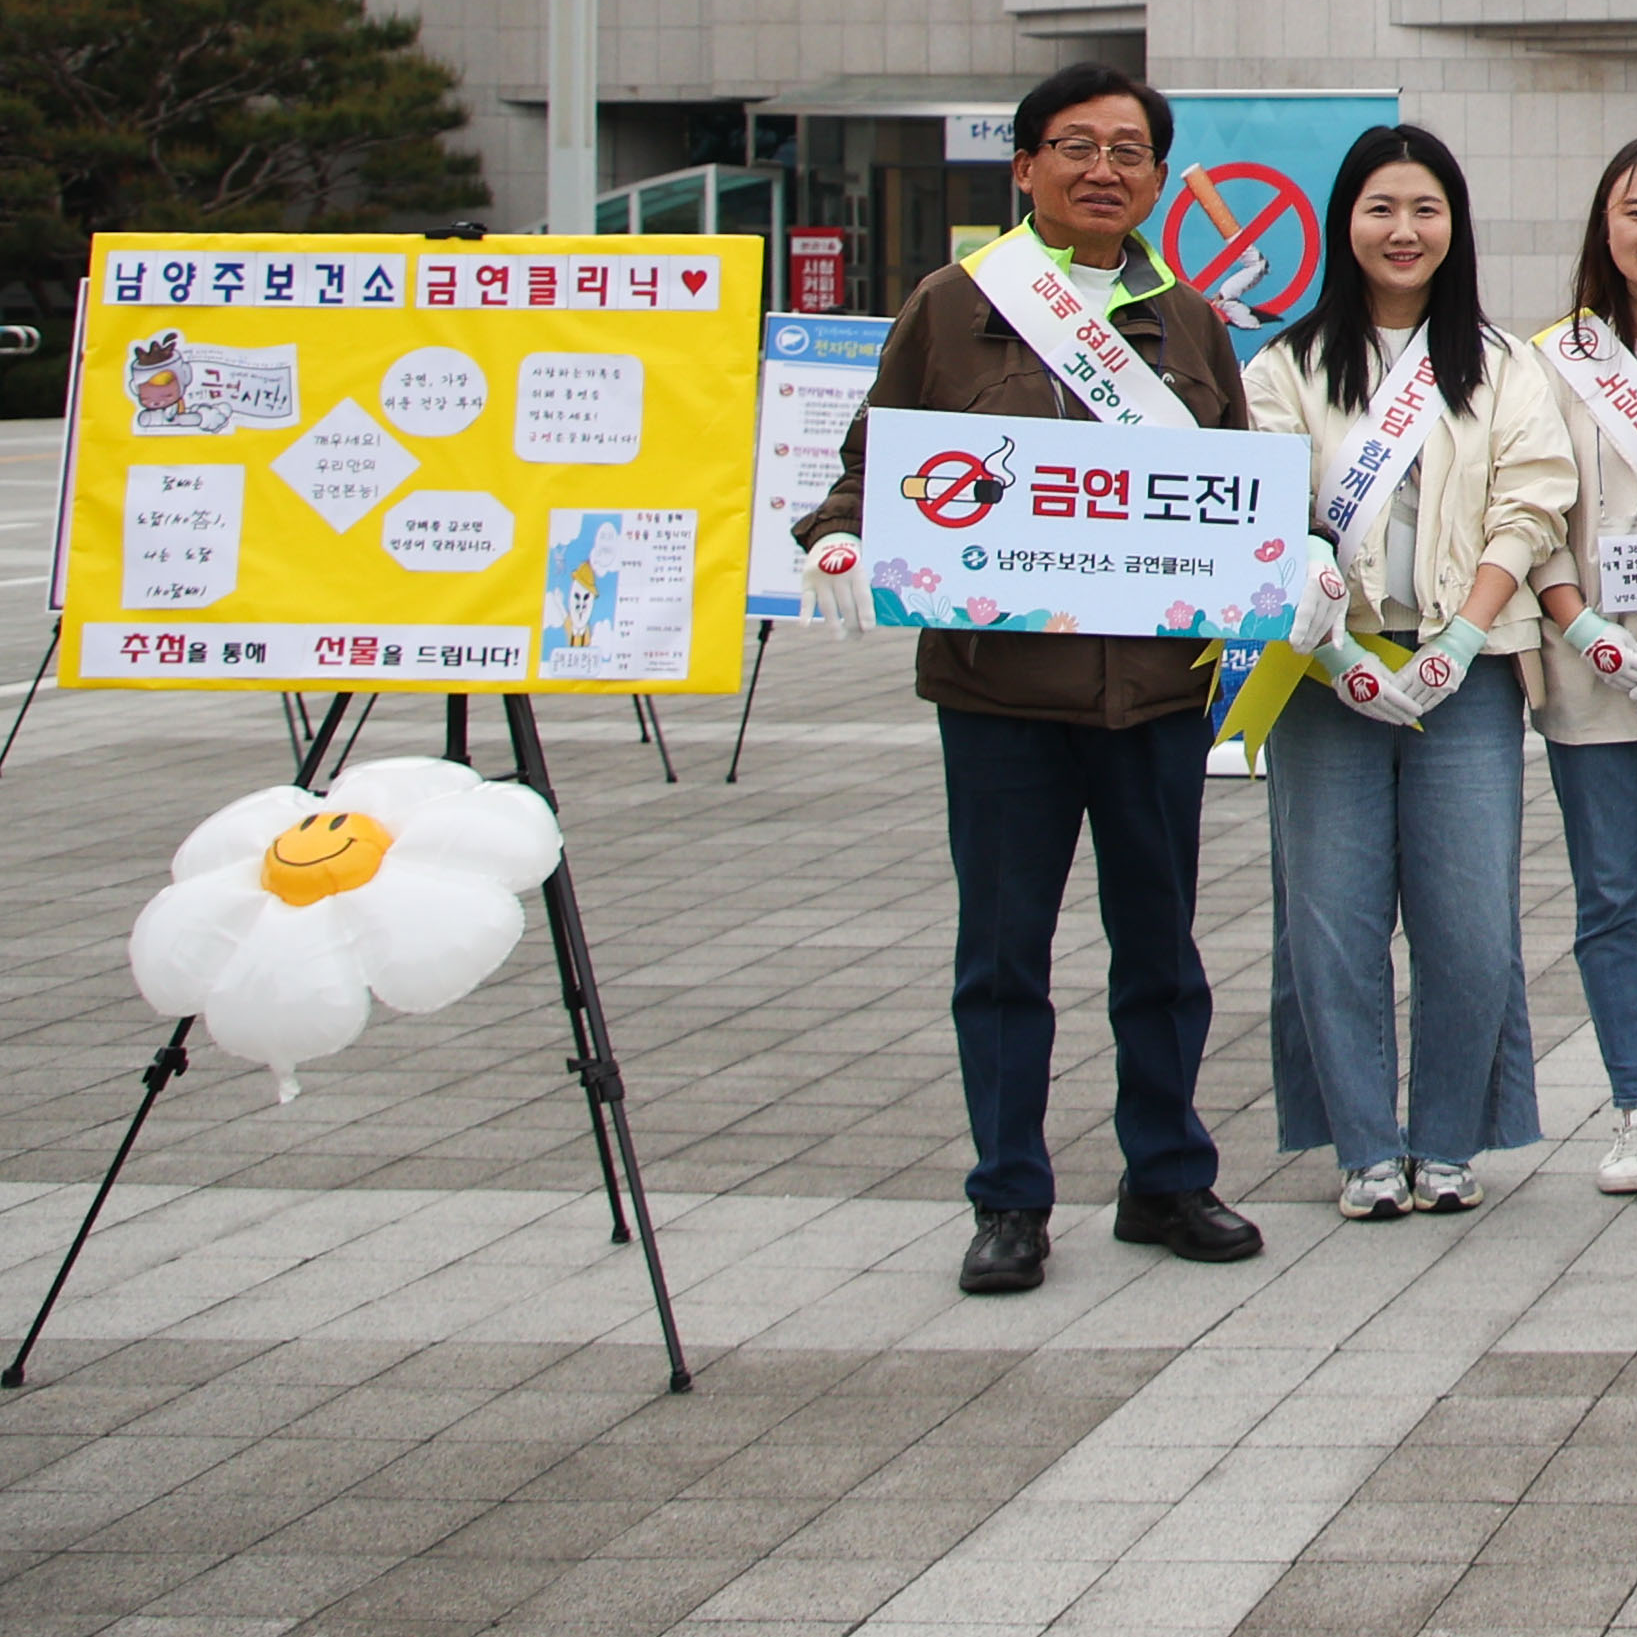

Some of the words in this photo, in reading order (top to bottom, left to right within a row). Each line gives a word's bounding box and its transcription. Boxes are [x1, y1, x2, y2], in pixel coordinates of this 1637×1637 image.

[116, 261, 395, 303] 남양주보건소
[426, 265, 659, 306] 금연클리닉
[1032, 270, 1083, 320] 담배
[1076, 318, 1130, 374] 없는
[441, 373, 468, 388] 가장
[162, 475, 203, 491] 담배는
[1030, 465, 1130, 520] 금연
[1143, 472, 1260, 525] 도전!
[144, 548, 170, 563] 나는
[185, 547, 213, 563] 노담
[997, 550, 1117, 574] 남양주보건소
[1125, 555, 1215, 576] 금연클리닉
[119, 633, 208, 665] 추첨을
[222, 642, 266, 664] 통해
[314, 635, 402, 666] 선물을
[416, 644, 519, 667] 드립니다!
